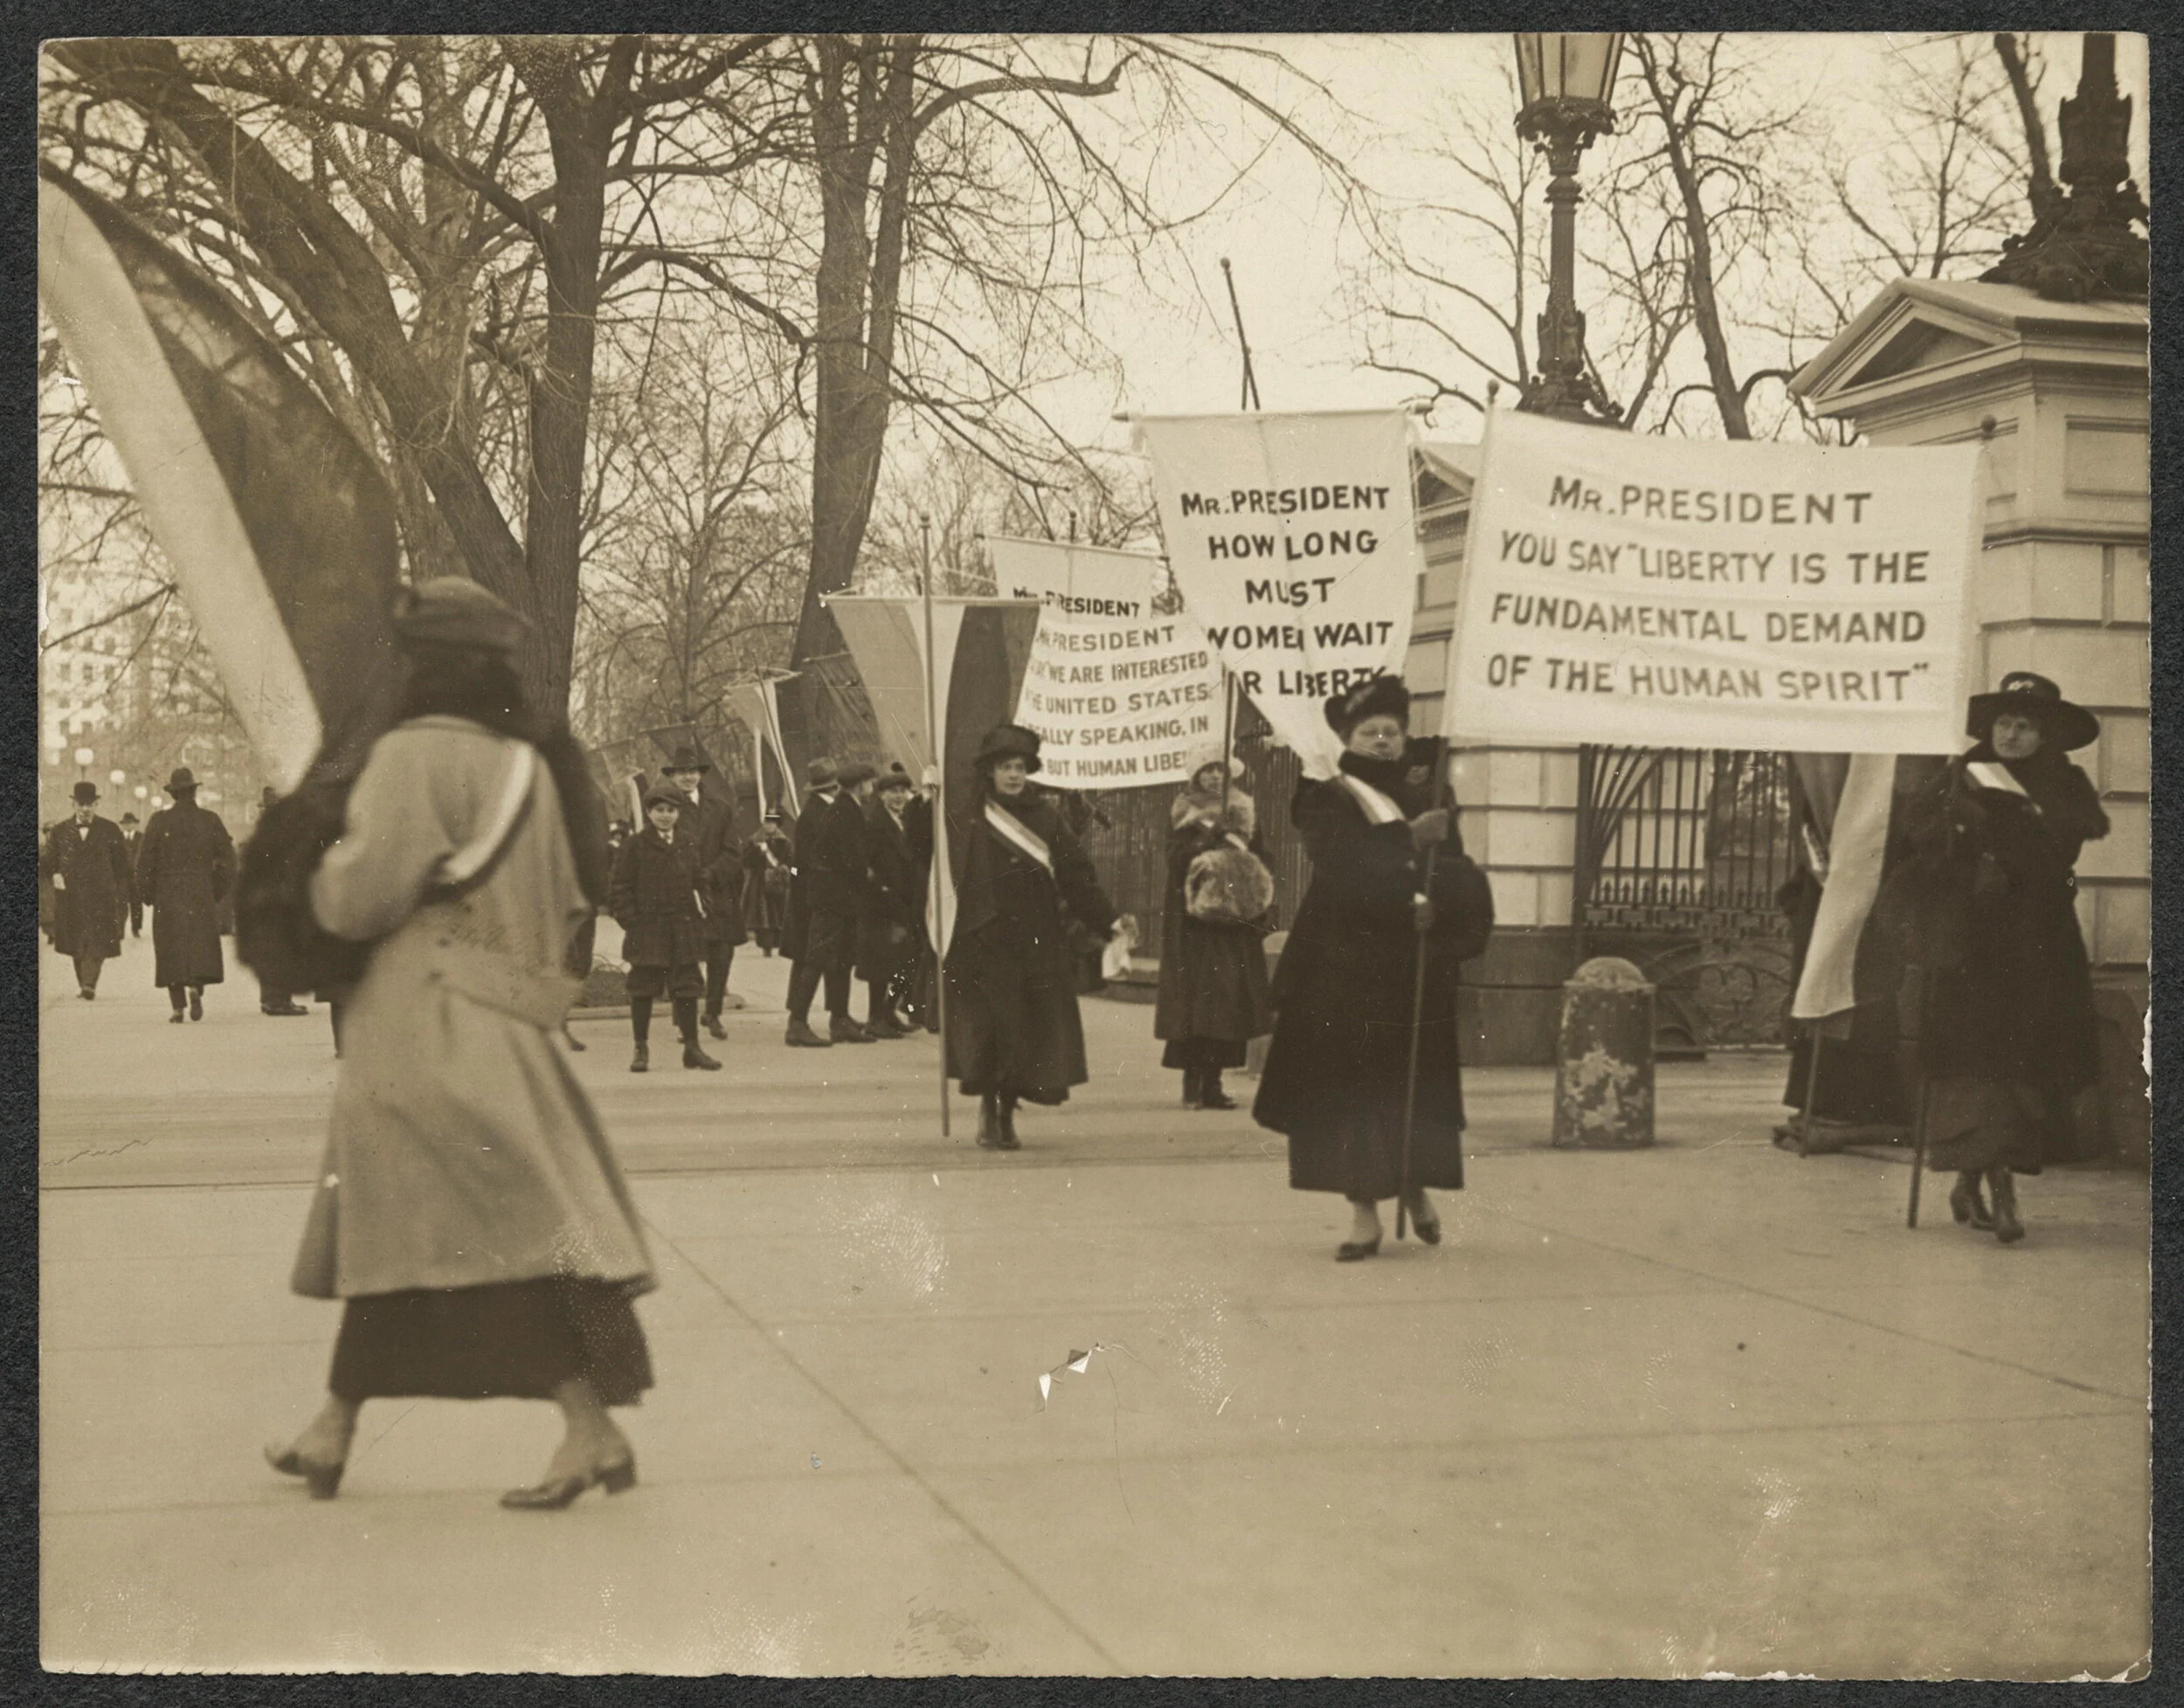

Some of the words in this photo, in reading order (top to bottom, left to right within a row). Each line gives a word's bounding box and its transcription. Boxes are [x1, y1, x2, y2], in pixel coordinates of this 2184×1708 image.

[1231, 485, 1390, 515] PRESIDENT
[1621, 484, 1872, 525] PRESIDENT
[1208, 535, 1275, 560] HOW
[1284, 529, 1379, 562] LONG
[1501, 529, 1557, 567] YOU
[1568, 540, 1621, 574] SAY
[1791, 552, 1827, 584] IS
[1847, 550, 1930, 584] THE
[1245, 577, 1336, 608] MUST
[1491, 592, 1747, 642] FUNDAMENTAL
[1766, 610, 1927, 644] DEMAND
[1314, 621, 1393, 649] WAIT
[1069, 665, 1103, 683] ARE
[1110, 650, 1209, 681] INTERESTED
[1488, 653, 1531, 688] OF
[1546, 657, 1614, 693] THE
[1629, 664, 1762, 699] HUMAN
[1047, 696, 1117, 715] UNITED
[1190, 715, 1209, 735] IN
[1047, 758, 1071, 777] BUT
[1075, 757, 1138, 777] HUMAN
